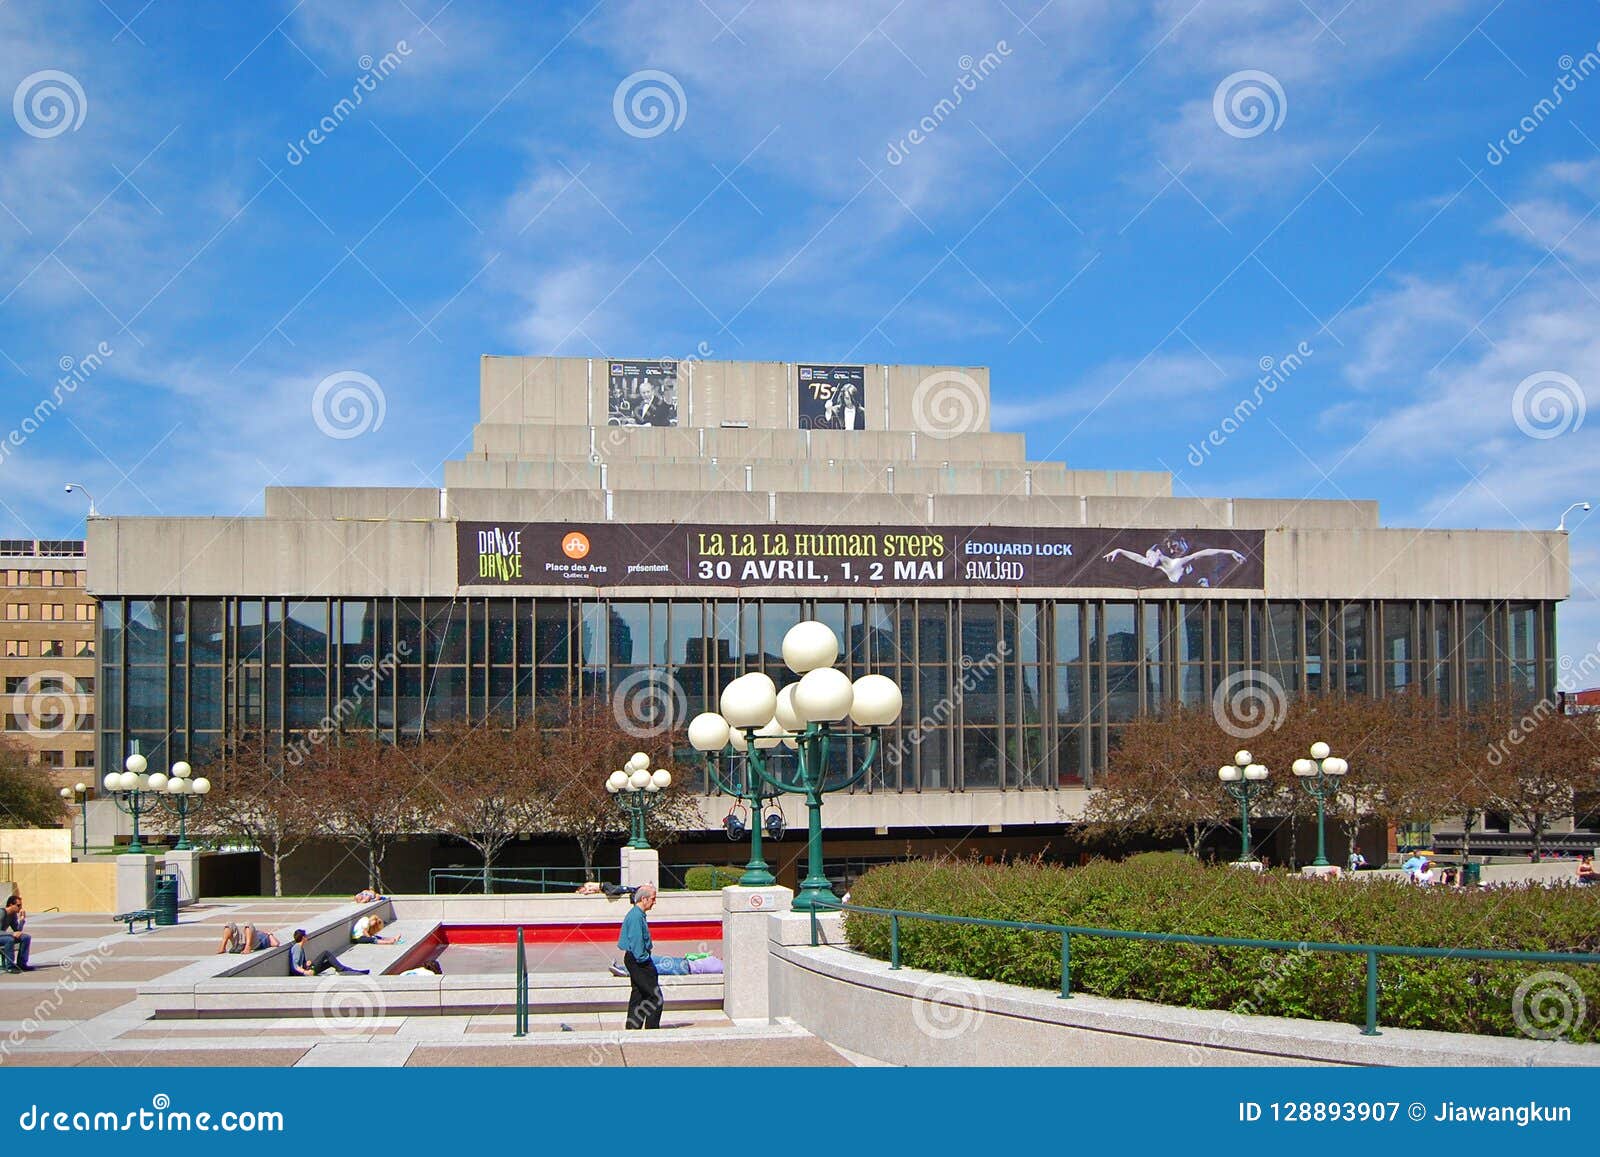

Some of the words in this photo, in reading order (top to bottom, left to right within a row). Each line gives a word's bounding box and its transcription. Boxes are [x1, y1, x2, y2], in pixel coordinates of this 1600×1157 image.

[478, 527, 521, 556] DANSE
[965, 540, 1032, 555] ÉDOUARD
[1036, 543, 1073, 556] LOCK
[479, 553, 523, 581] DANSE
[545, 562, 569, 572] Place
[571, 562, 587, 572] des
[589, 563, 607, 573] Arts
[627, 562, 669, 573] présentent
[698, 560, 732, 579] 30
[741, 560, 829, 581] AVRIL,
[841, 561, 859, 582] 1,
[869, 562, 884, 580] 2
[894, 561, 944, 580] MAI
